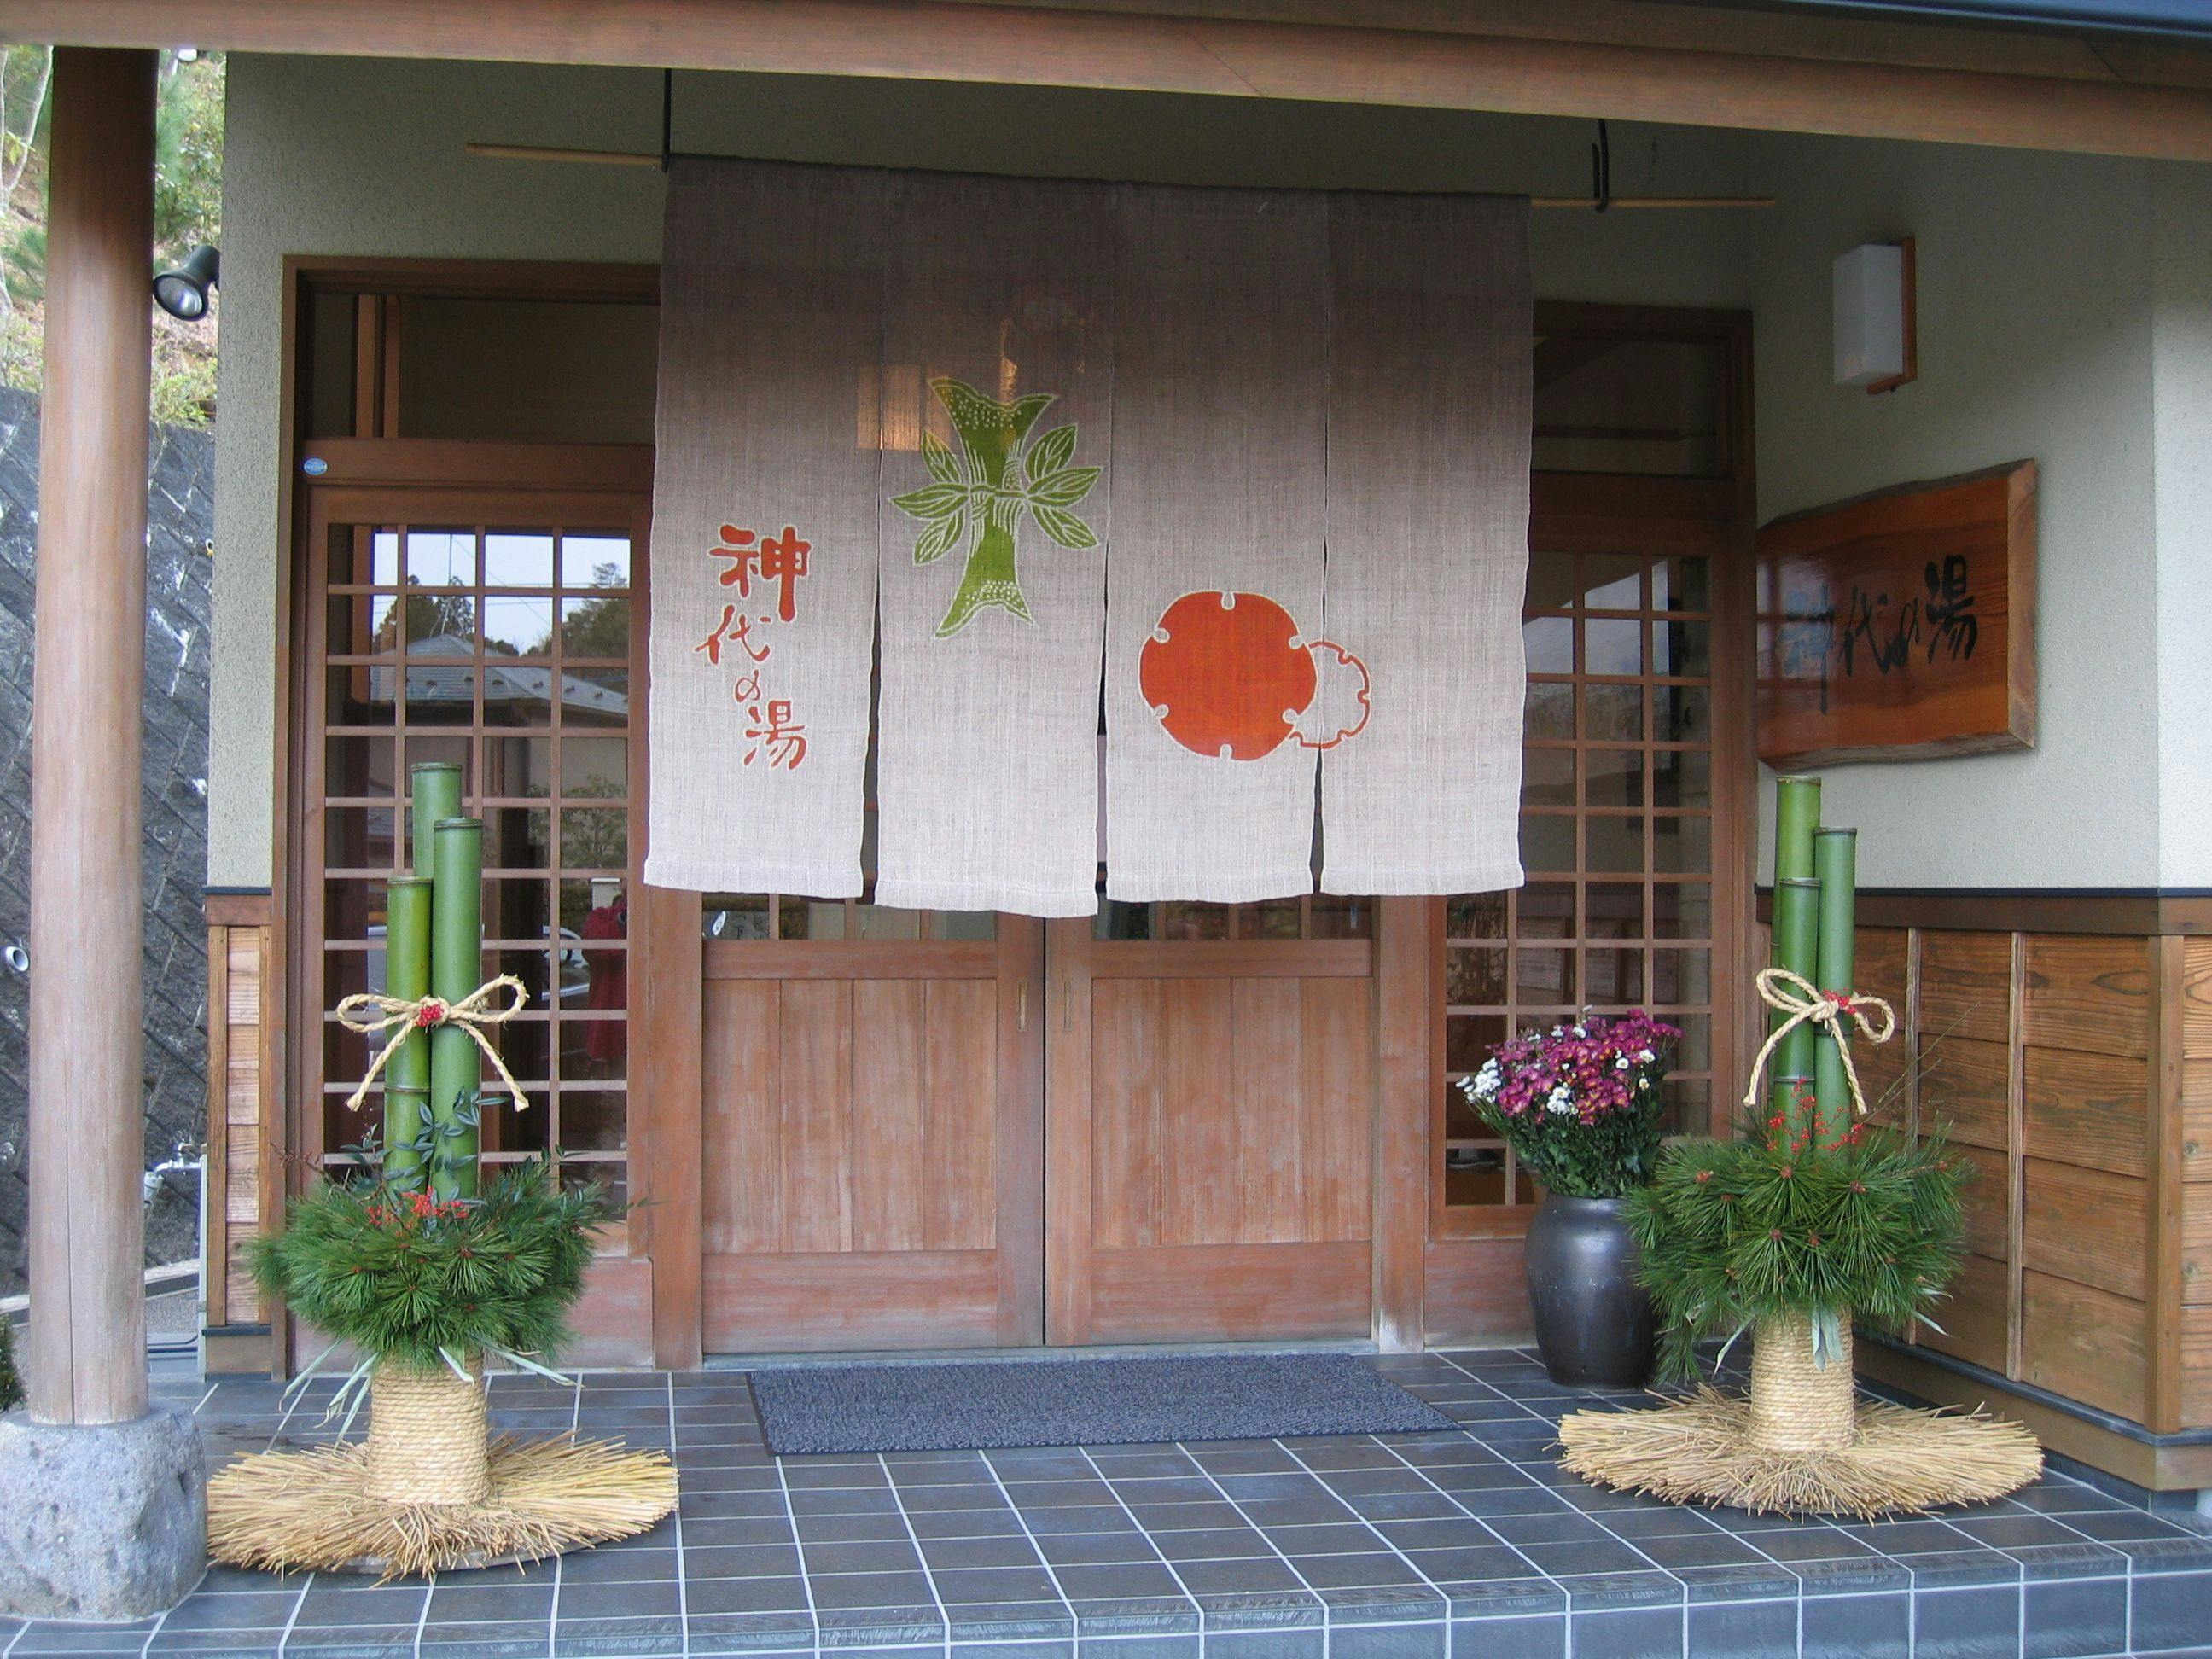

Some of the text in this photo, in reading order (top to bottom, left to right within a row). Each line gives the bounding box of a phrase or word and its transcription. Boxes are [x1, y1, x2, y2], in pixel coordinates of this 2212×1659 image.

[695, 523, 812, 771] 神代の湯
[1777, 554, 1979, 715] 神代の湯
